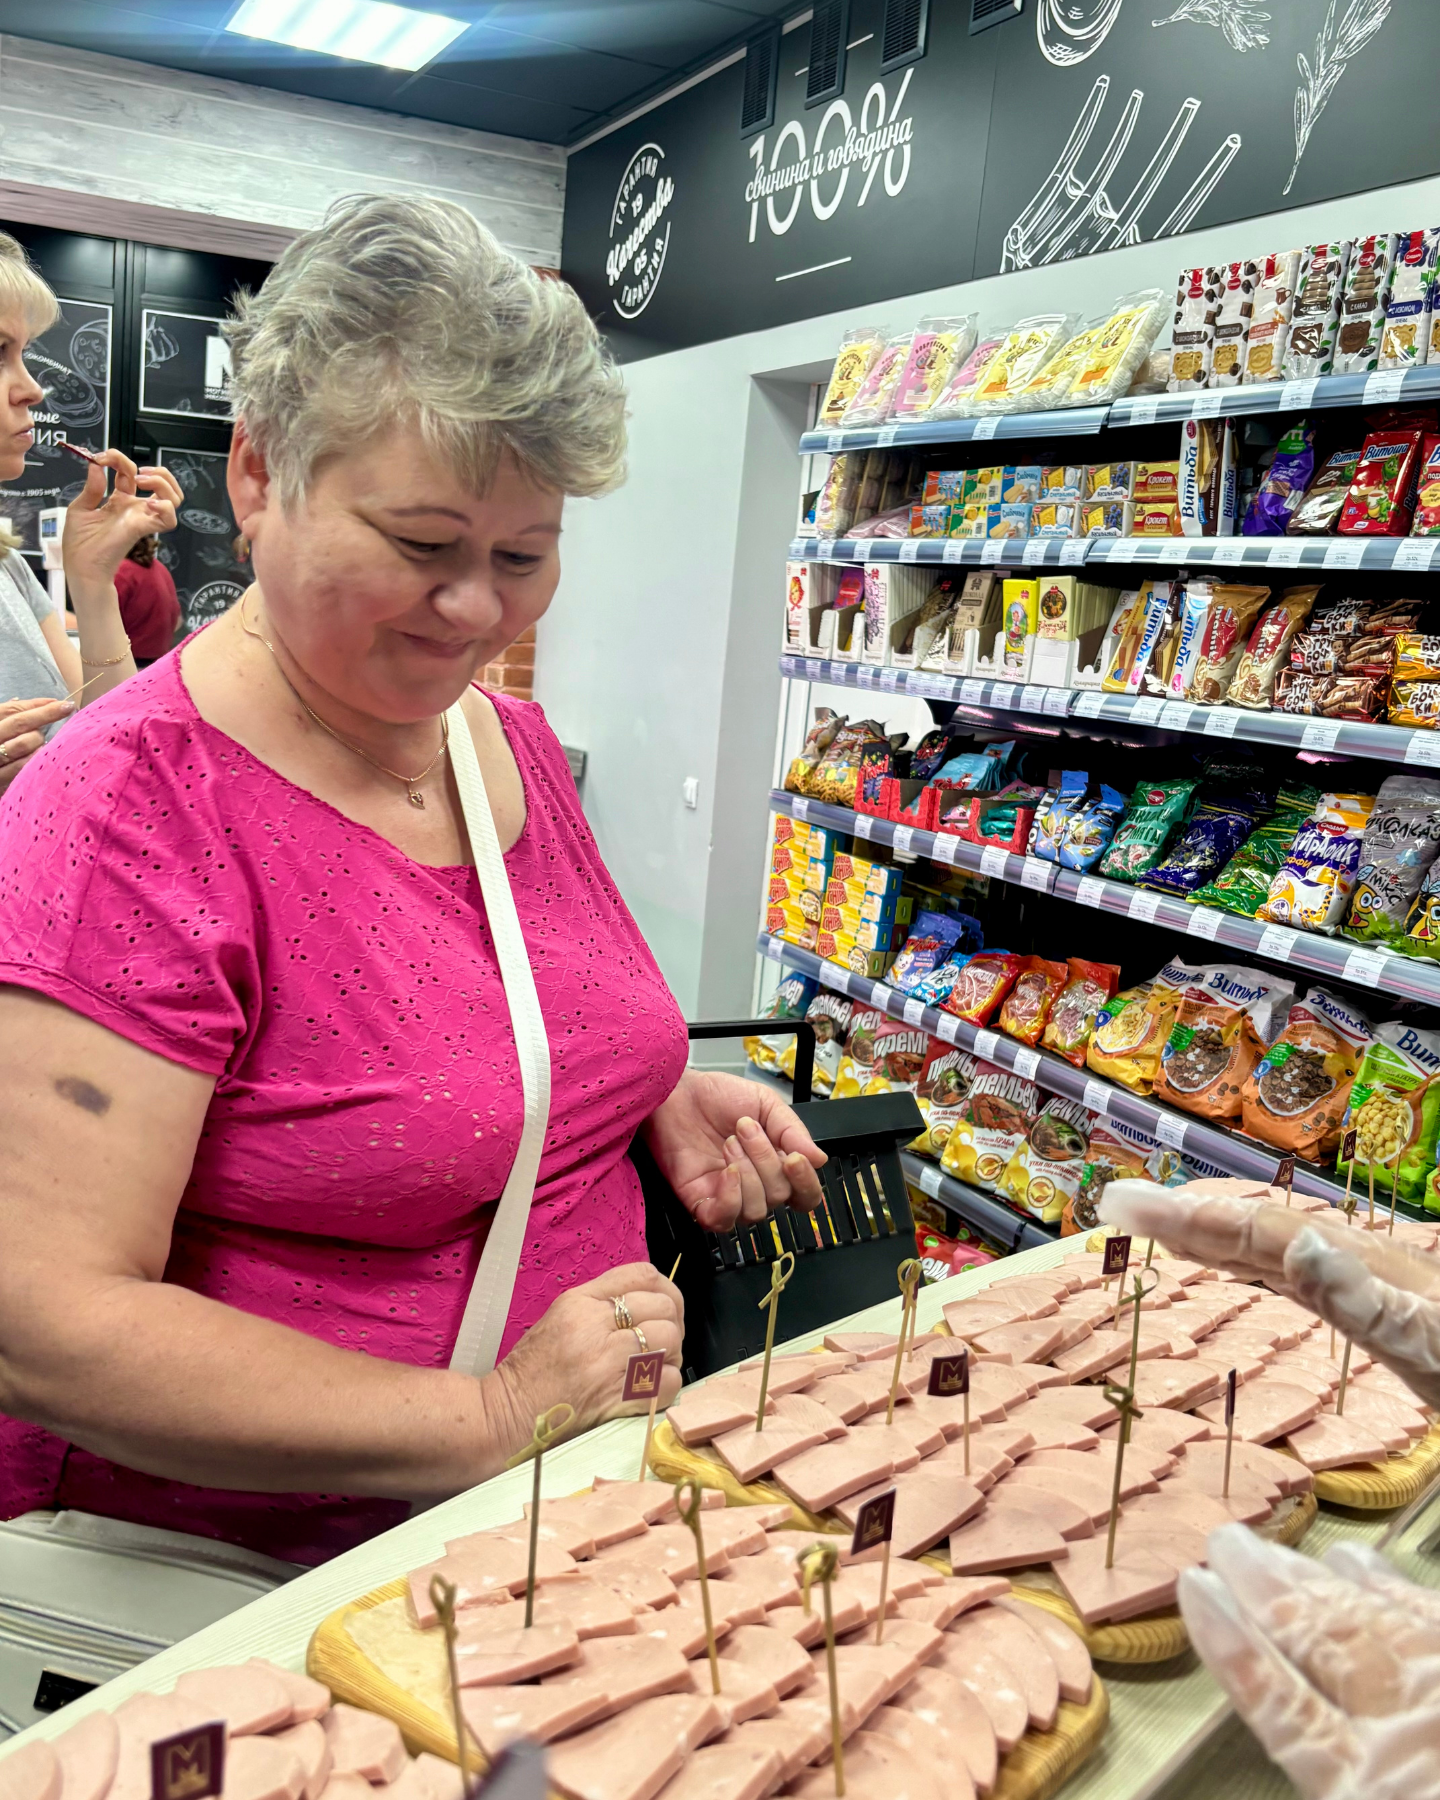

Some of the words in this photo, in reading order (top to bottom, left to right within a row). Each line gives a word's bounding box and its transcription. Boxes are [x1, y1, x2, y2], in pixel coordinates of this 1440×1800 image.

[745, 160, 811, 203] свинина
[811, 153, 826, 175] и
[827, 116, 914, 173] говядина
[748, 68, 914, 243] 100%
[616, 155, 660, 225] ГАРАНТИЯ
[631, 193, 644, 218] 19
[633, 249, 648, 277] 05
[621, 237, 664, 309] ГАРАНТИЯ
[1328, 451, 1361, 465] Витош
[1364, 443, 1410, 460] Витоша
[1147, 475, 1173, 484] Крокет
[1181, 446, 1198, 519] Витьба
[1223, 469, 1235, 519] Витьба
[1145, 515, 1168, 525] Крокет
[775, 826, 794, 844] CHIPS
[774, 857, 793, 874] CHIPS
[834, 865, 854, 881] CHIPS
[770, 886, 790, 904] CHIPS
[827, 890, 847, 906] CHIPS
[767, 916, 787, 933] CHIPS
[823, 916, 843, 932] CHIPS
[818, 941, 837, 958] CHIPS
[1396, 1028, 1440, 1069] Вит
